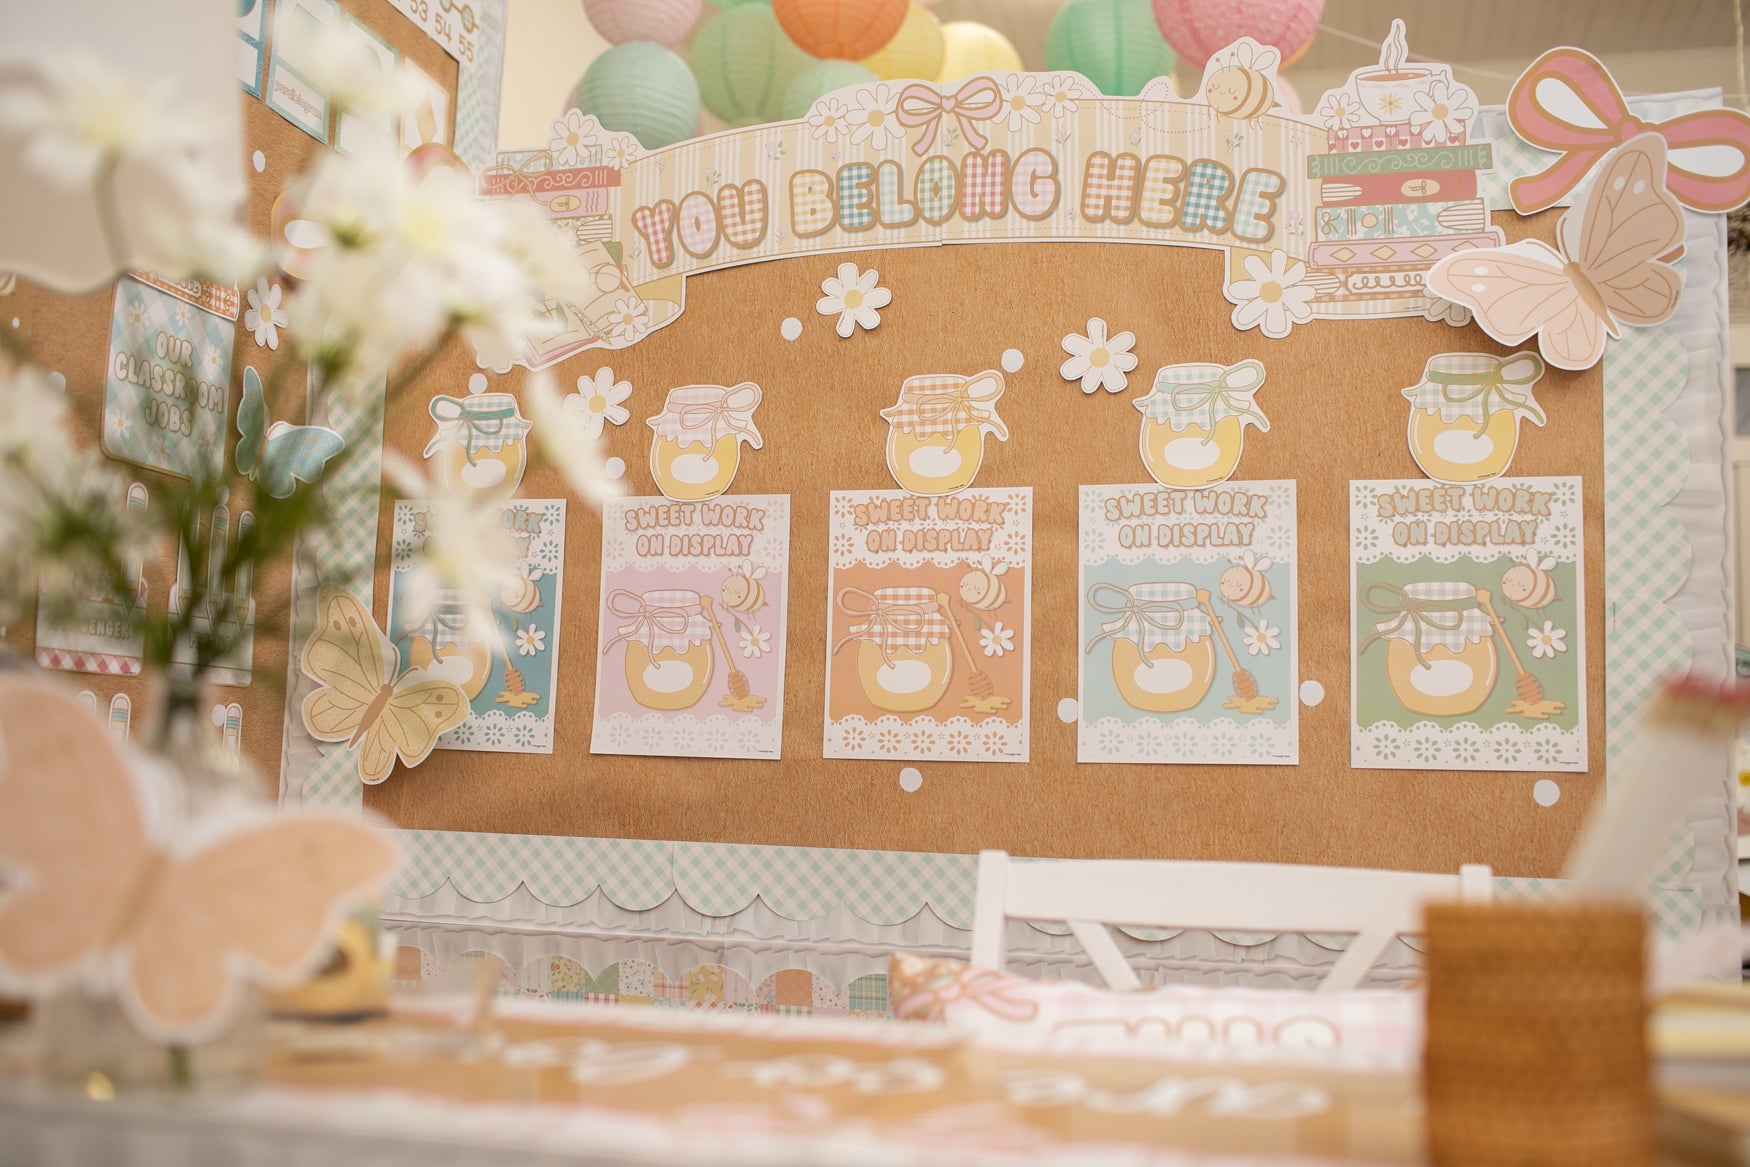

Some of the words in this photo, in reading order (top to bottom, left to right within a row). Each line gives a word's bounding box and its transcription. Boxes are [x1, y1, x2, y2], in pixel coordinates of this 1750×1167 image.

[435, 12, 452, 41] 54
[458, 34, 475, 62] 55
[631, 179, 768, 268] YOU
[789, 147, 1061, 239] BELONG
[1080, 150, 1285, 243] HERE
[155, 331, 194, 369] OUR
[113, 351, 225, 414] CLASSROOM
[143, 399, 193, 437] JOBS
[625, 504, 695, 532] SWEET
[701, 503, 766, 531] WORK
[854, 497, 931, 526] SWEET
[936, 498, 1006, 525] WORK
[1104, 491, 1187, 522] SWEET
[1193, 490, 1268, 519] WORK
[1377, 486, 1466, 518] SWEET
[1472, 486, 1552, 517] WORK
[636, 534, 665, 557] ON
[669, 534, 753, 557] DISPLAY
[866, 529, 897, 552] ON
[902, 528, 993, 552] DISPLAY
[1118, 524, 1151, 549] ON
[1157, 522, 1255, 547] DISPLAY
[1393, 521, 1427, 546] ON
[1434, 520, 1539, 545] DISPLAY
